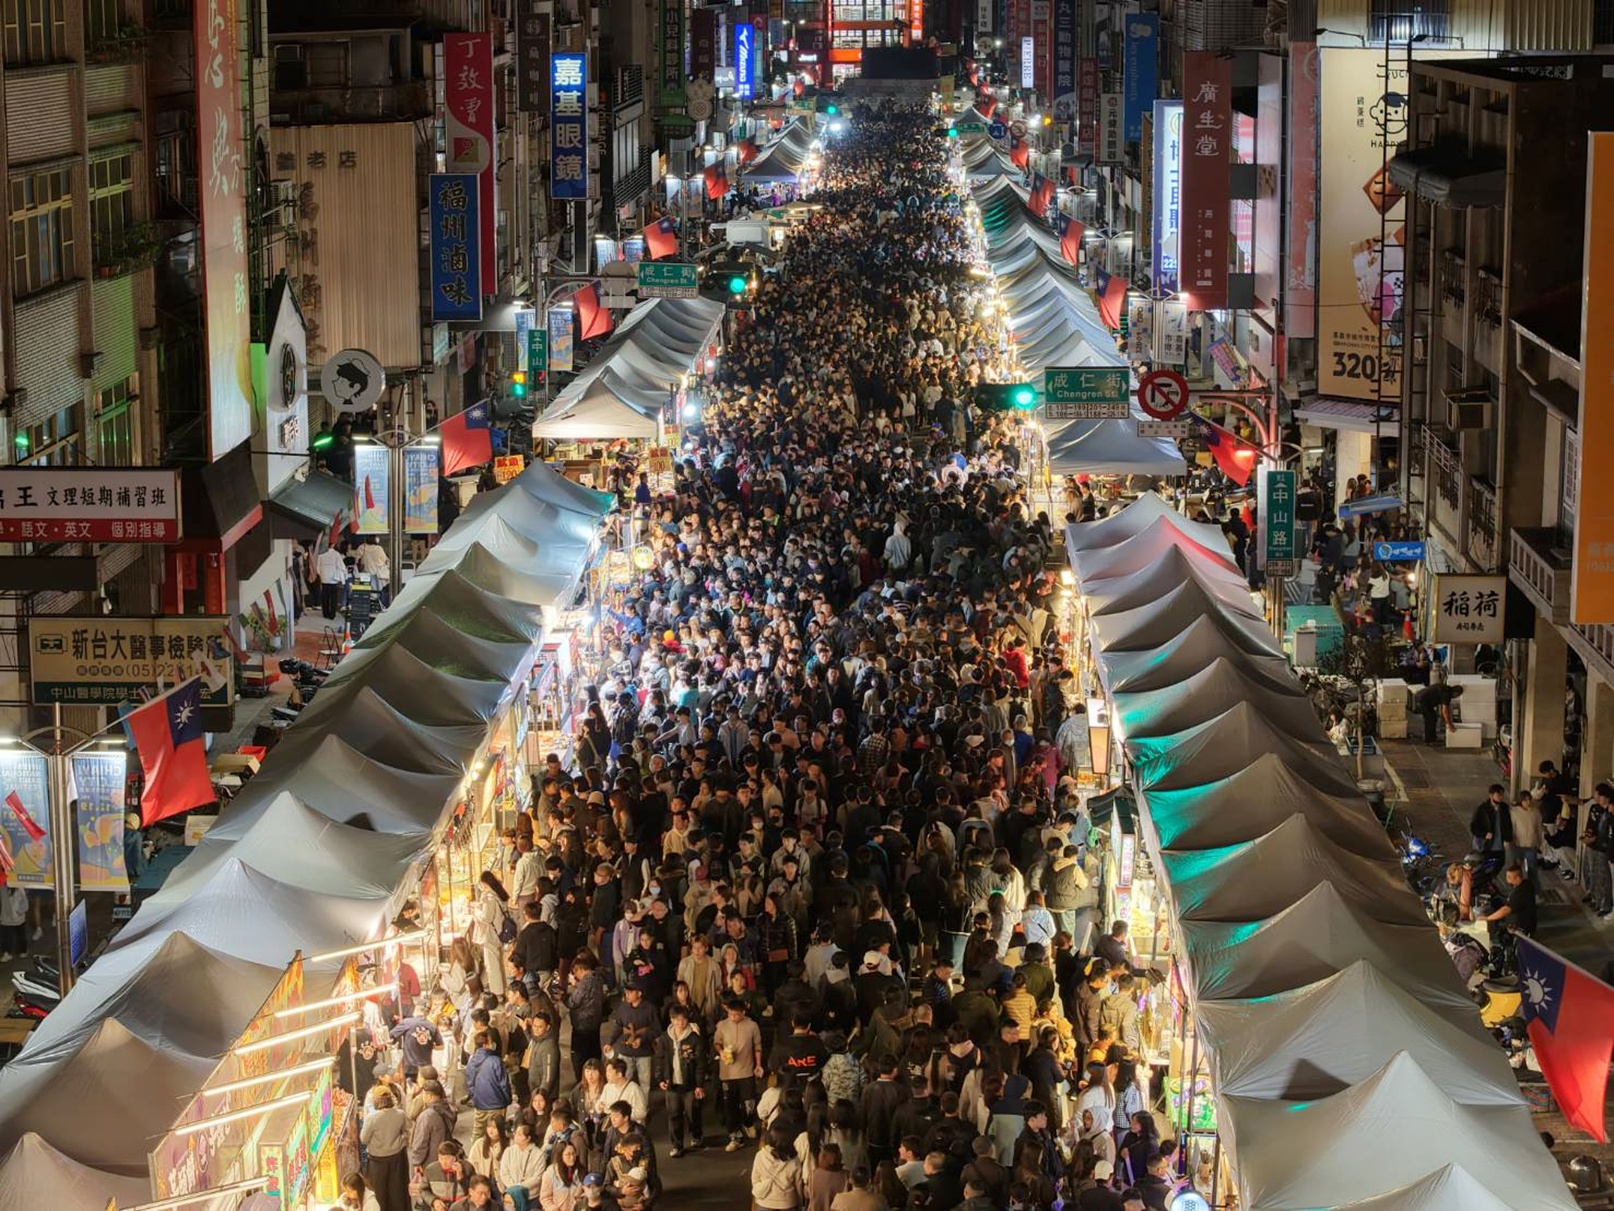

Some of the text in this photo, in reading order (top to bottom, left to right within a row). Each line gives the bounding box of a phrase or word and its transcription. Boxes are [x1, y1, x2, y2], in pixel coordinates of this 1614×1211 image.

[1023, 38, 1033, 79] PIERRE
[554, 58, 583, 182] 嘉基眼鏡
[1192, 80, 1224, 157] 廣生堂
[438, 181, 474, 307] 福州滷味
[645, 265, 692, 278] 成仁街
[1054, 373, 1120, 388] 成仁街
[1057, 390, 1102, 400] Chengren
[47, 487, 166, 507] 文理短期補習班
[112, 521, 166, 538] 個別指導
[1272, 489, 1288, 545] 中山路
[1442, 591, 1499, 618] 稻荷
